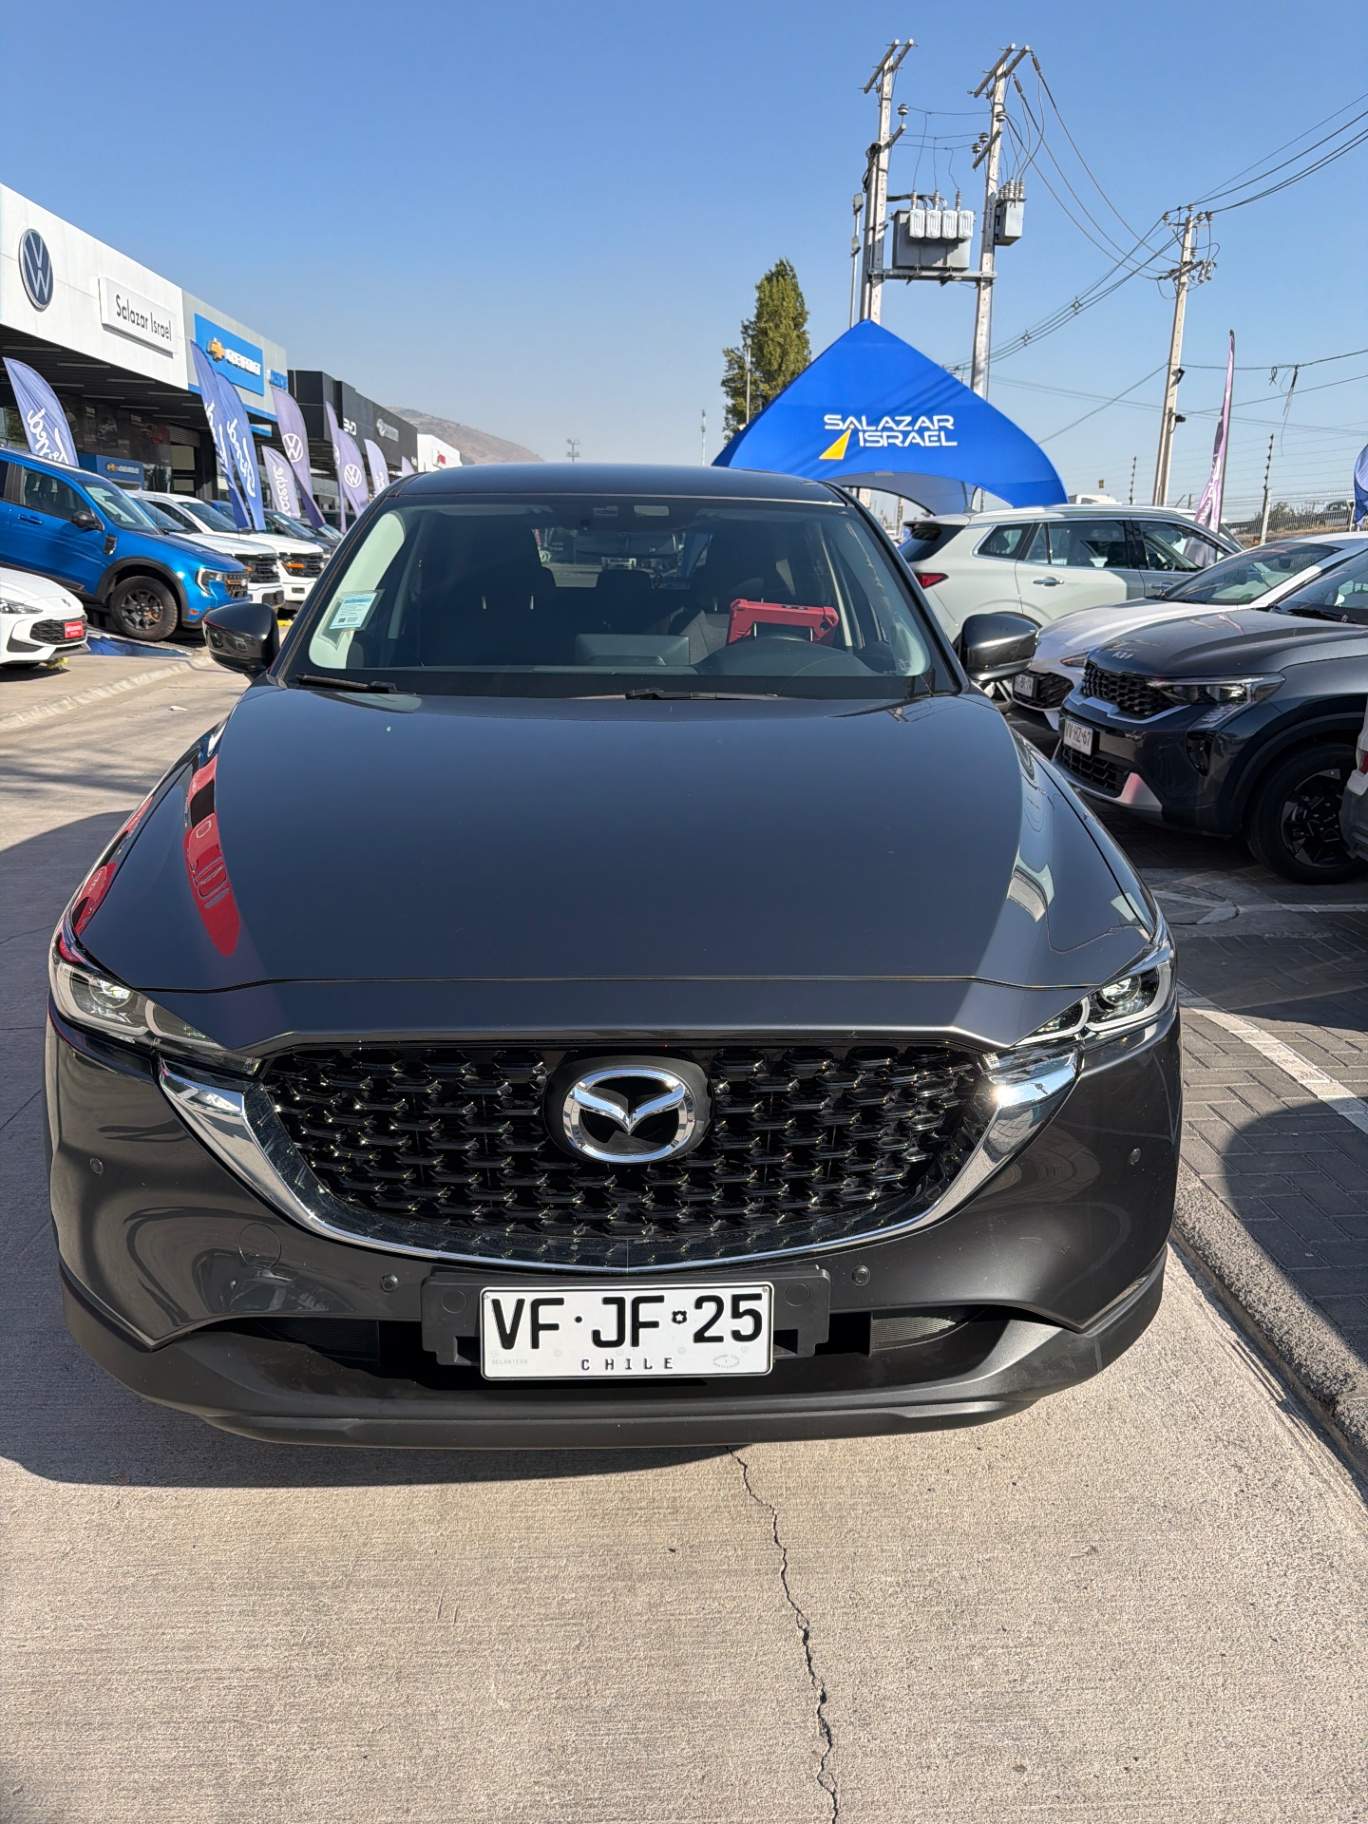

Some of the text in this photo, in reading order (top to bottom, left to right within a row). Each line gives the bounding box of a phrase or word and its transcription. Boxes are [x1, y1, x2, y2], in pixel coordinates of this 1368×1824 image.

[115, 293, 172, 342] Salazar Israel
[823, 414, 955, 430] SALAZAR
[858, 431, 958, 447] ISRAEL
[581, 1357, 673, 1371] CHILE
